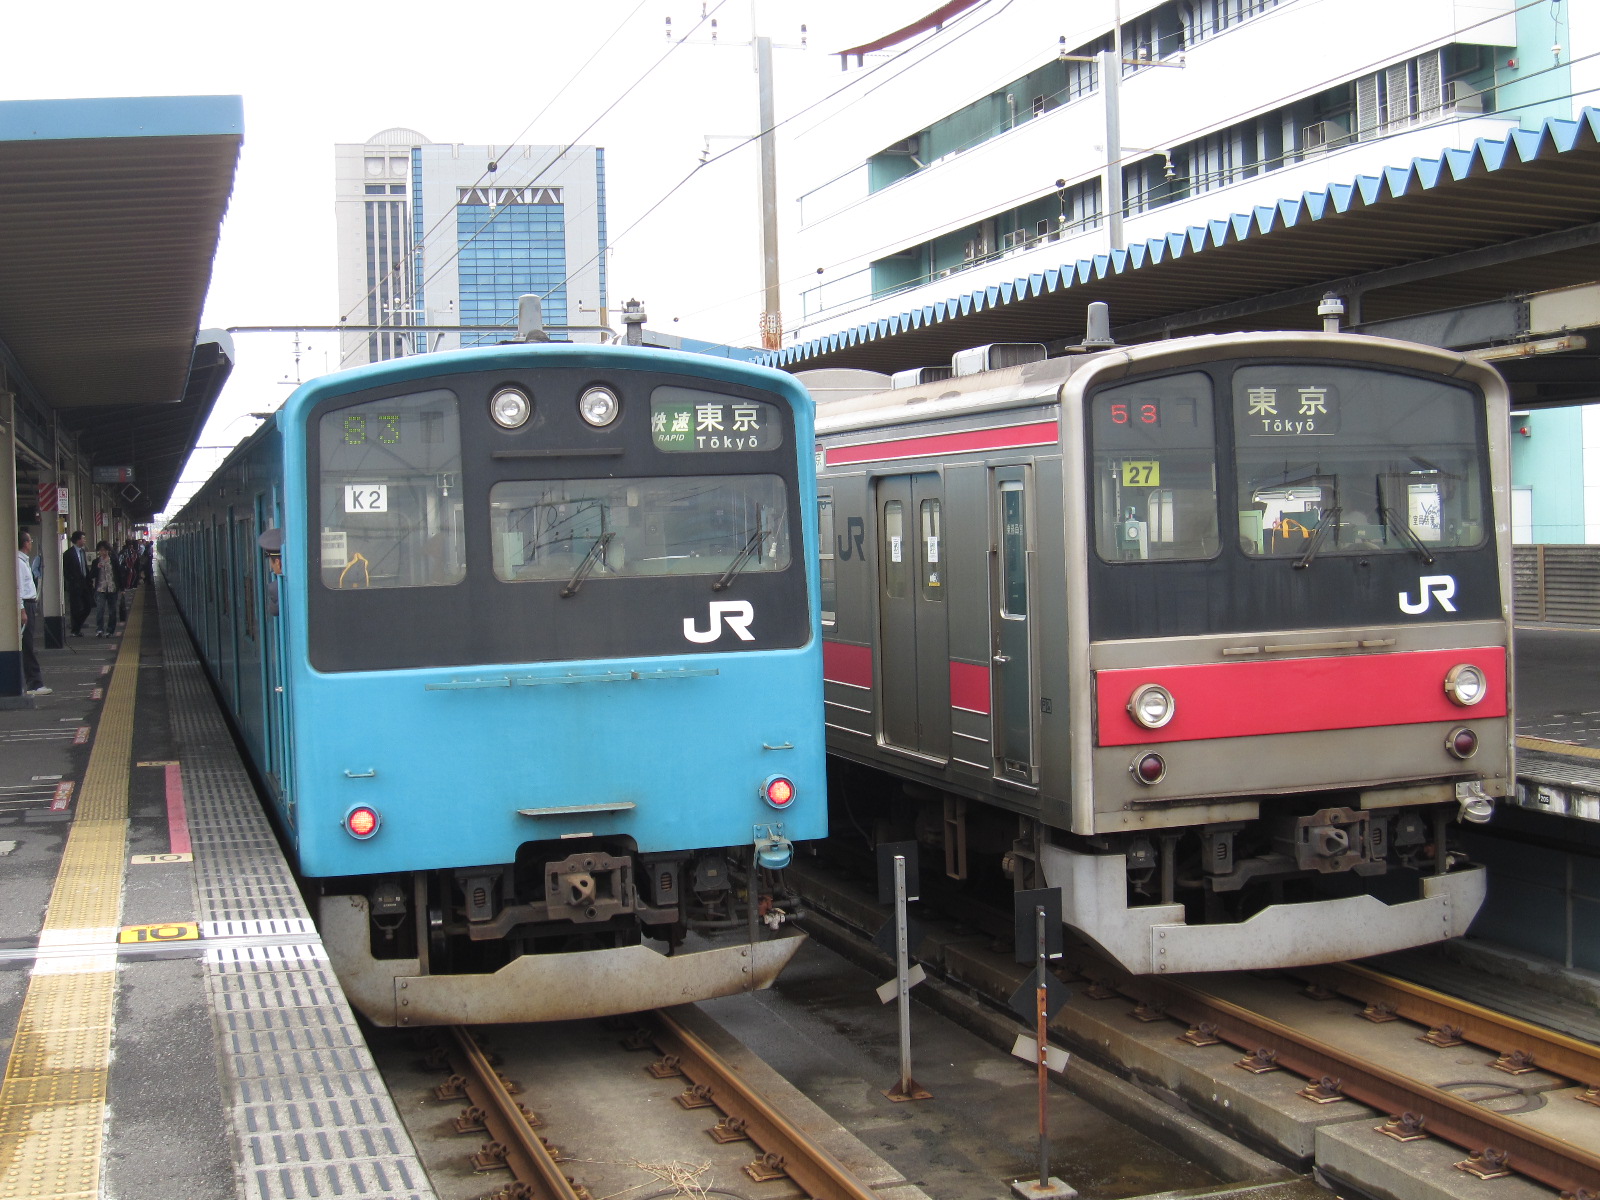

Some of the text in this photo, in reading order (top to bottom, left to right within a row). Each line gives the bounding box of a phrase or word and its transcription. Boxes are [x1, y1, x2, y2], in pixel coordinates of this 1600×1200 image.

[1247, 386, 1327, 415] 東京
[651, 412, 691, 432] 快速
[695, 402, 760, 432] 東京
[1111, 404, 1157, 424] 53
[344, 416, 399, 444] 83
[1262, 419, 1314, 434] Tōkyō
[658, 434, 685, 442] RAPID
[696, 435, 758, 450] Tōkyō
[126, 468, 132, 477] 3
[1129, 466, 1153, 484] 27
[352, 490, 381, 509] K2
[838, 516, 866, 561] JR
[1398, 574, 1457, 615] JR
[683, 600, 756, 643] JR
[144, 854, 182, 862] 10
[131, 926, 188, 941] 10
